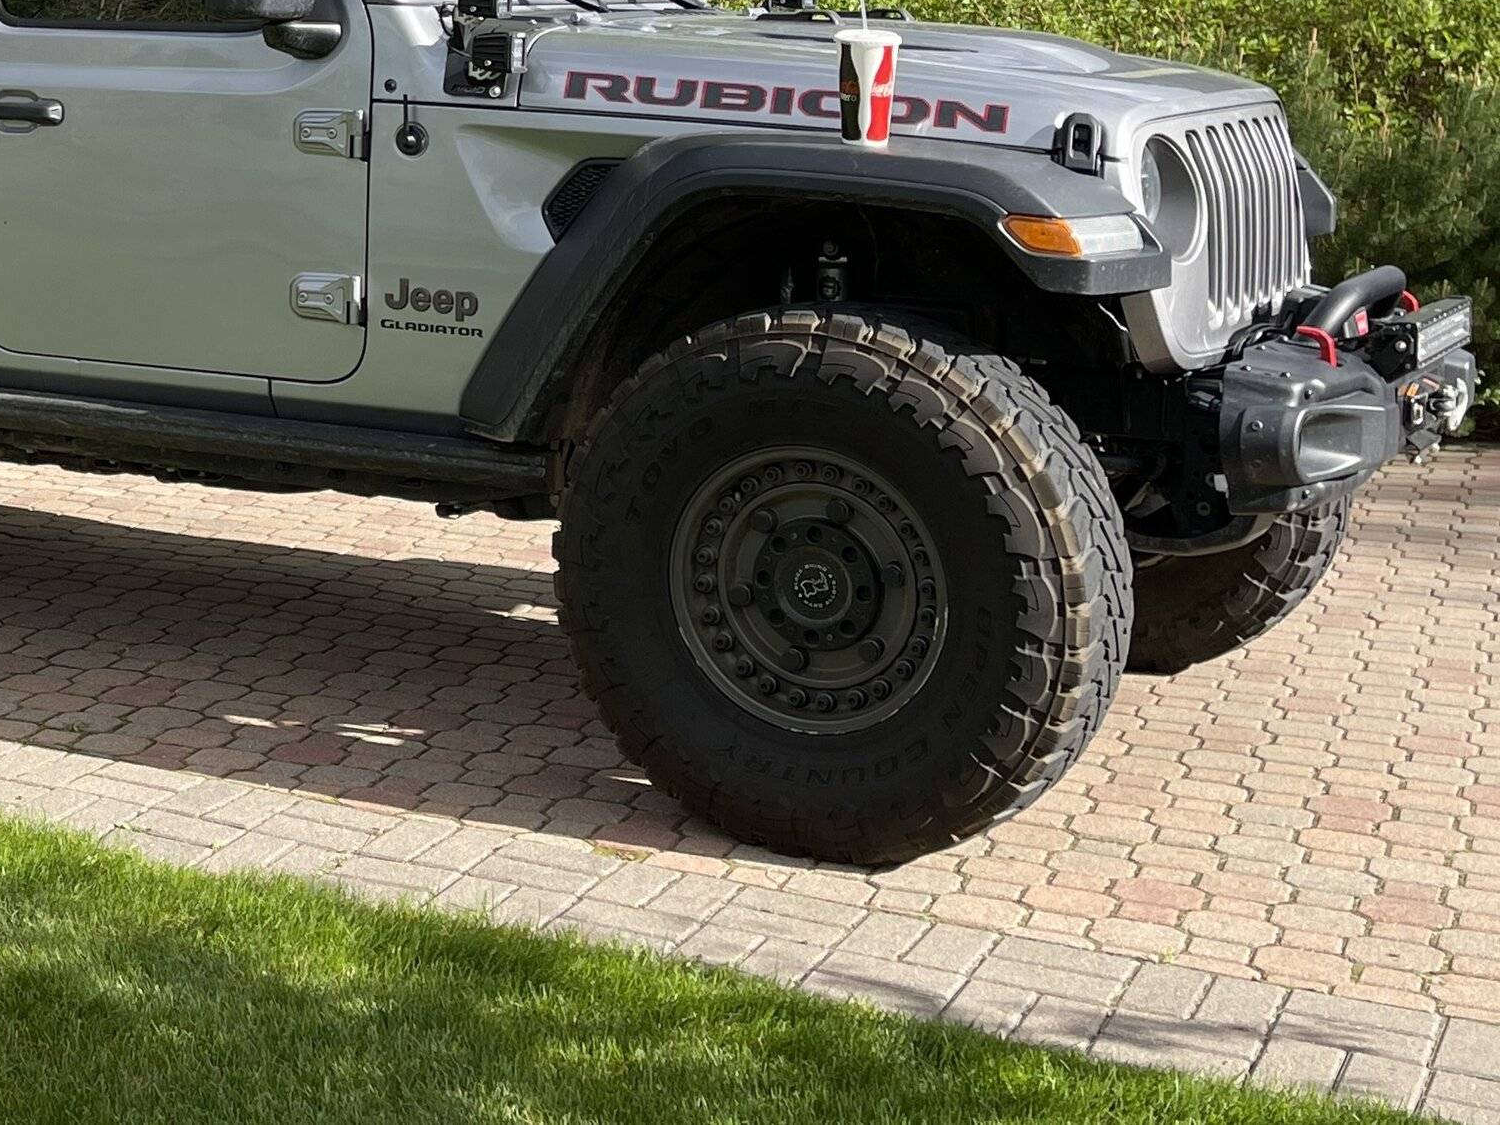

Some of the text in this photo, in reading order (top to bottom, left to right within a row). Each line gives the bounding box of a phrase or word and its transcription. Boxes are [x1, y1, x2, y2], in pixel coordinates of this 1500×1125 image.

[563, 70, 1010, 135] RUBICON
[384, 278, 479, 322] Jeep
[380, 319, 484, 338] GLADIATOR
